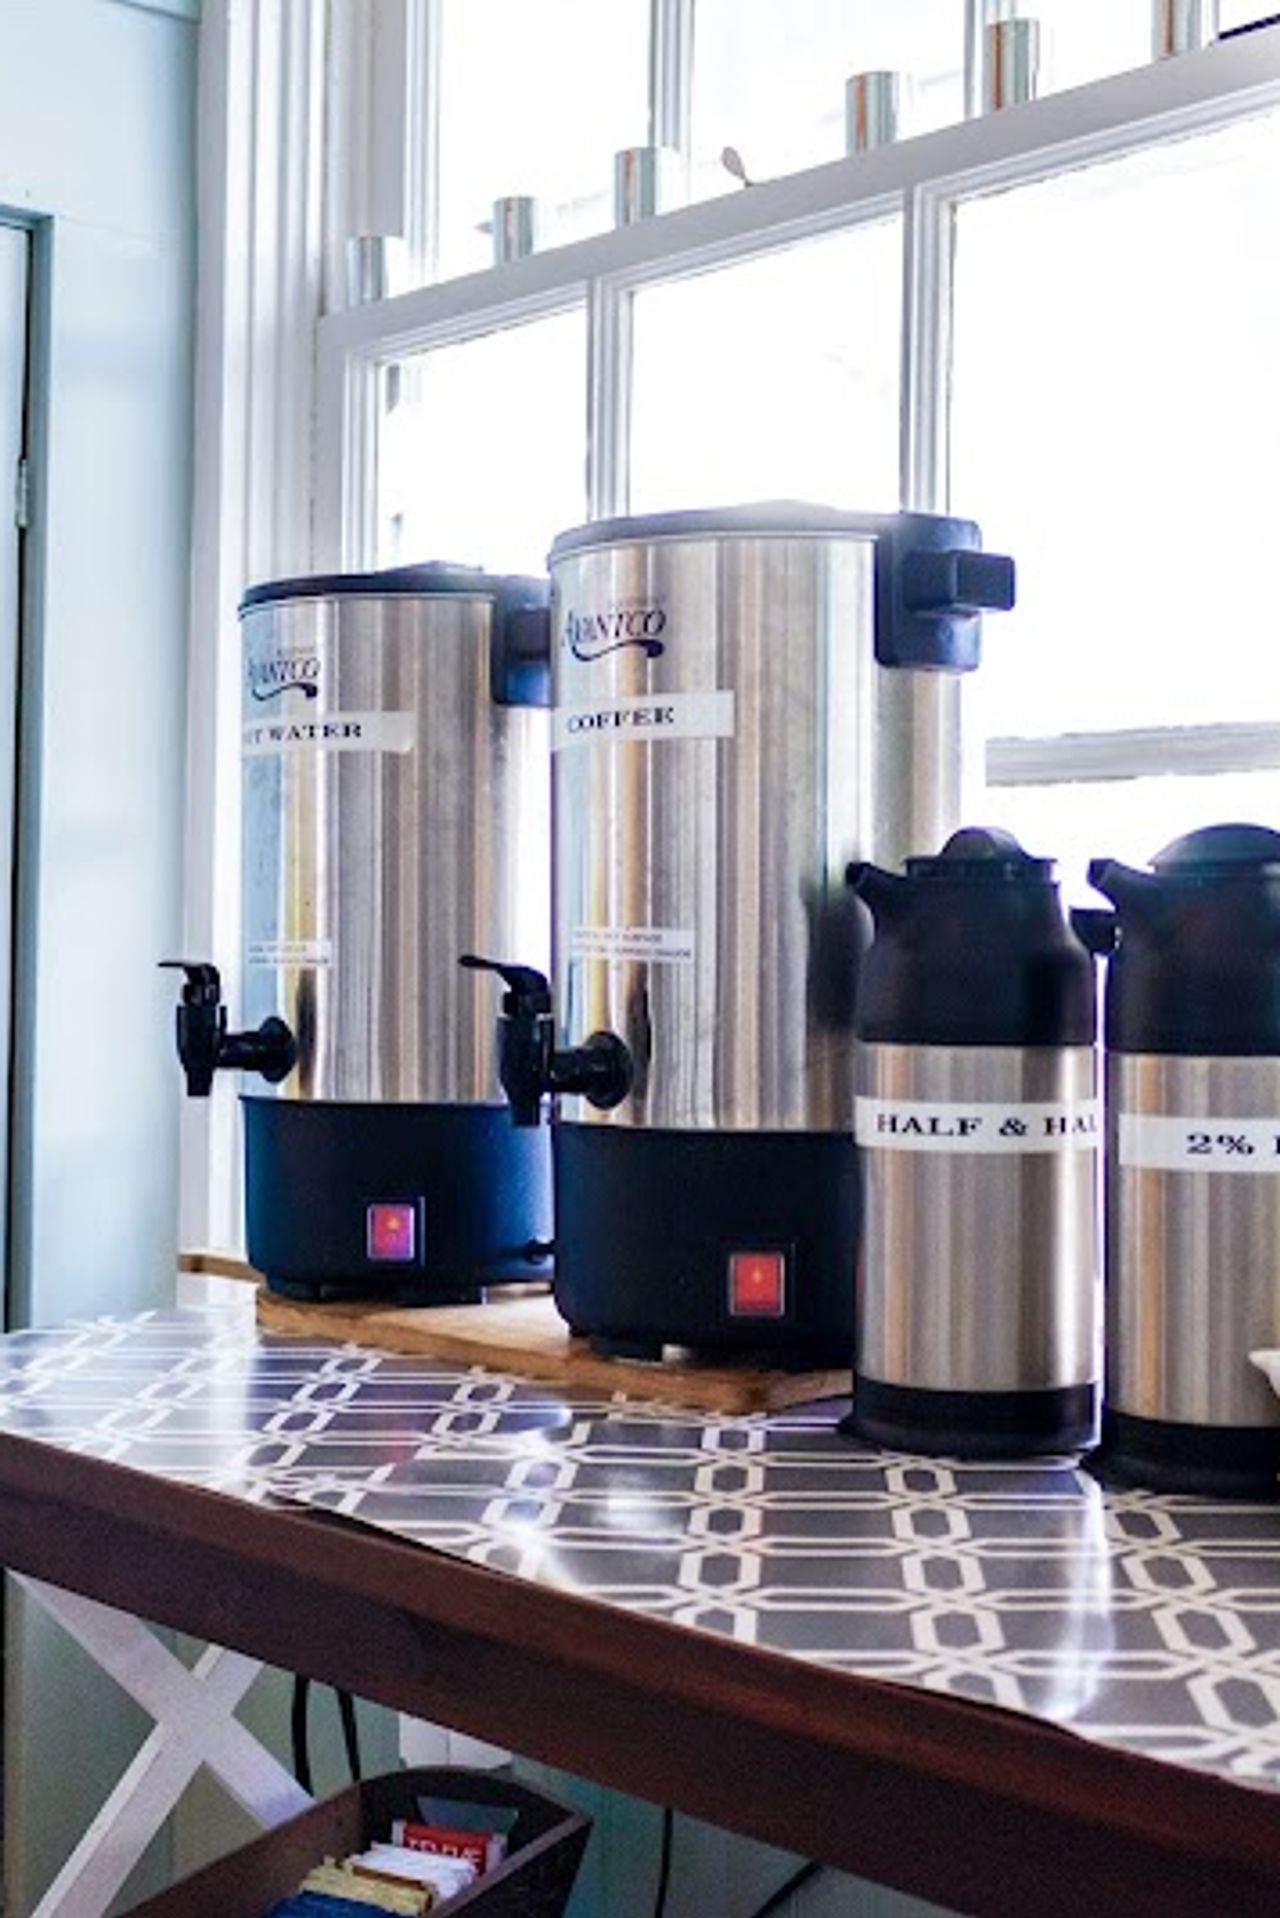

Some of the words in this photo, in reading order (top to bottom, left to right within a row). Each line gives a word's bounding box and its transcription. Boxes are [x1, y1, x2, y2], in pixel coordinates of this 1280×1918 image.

[267, 723, 362, 741] WATER
[568, 707, 674, 733] COFFEE
[877, 1114, 983, 1136] HALF
[999, 1117, 1028, 1137] &
[1042, 1114, 1098, 1136] HAL
[1186, 1131, 1256, 1156] 2%
